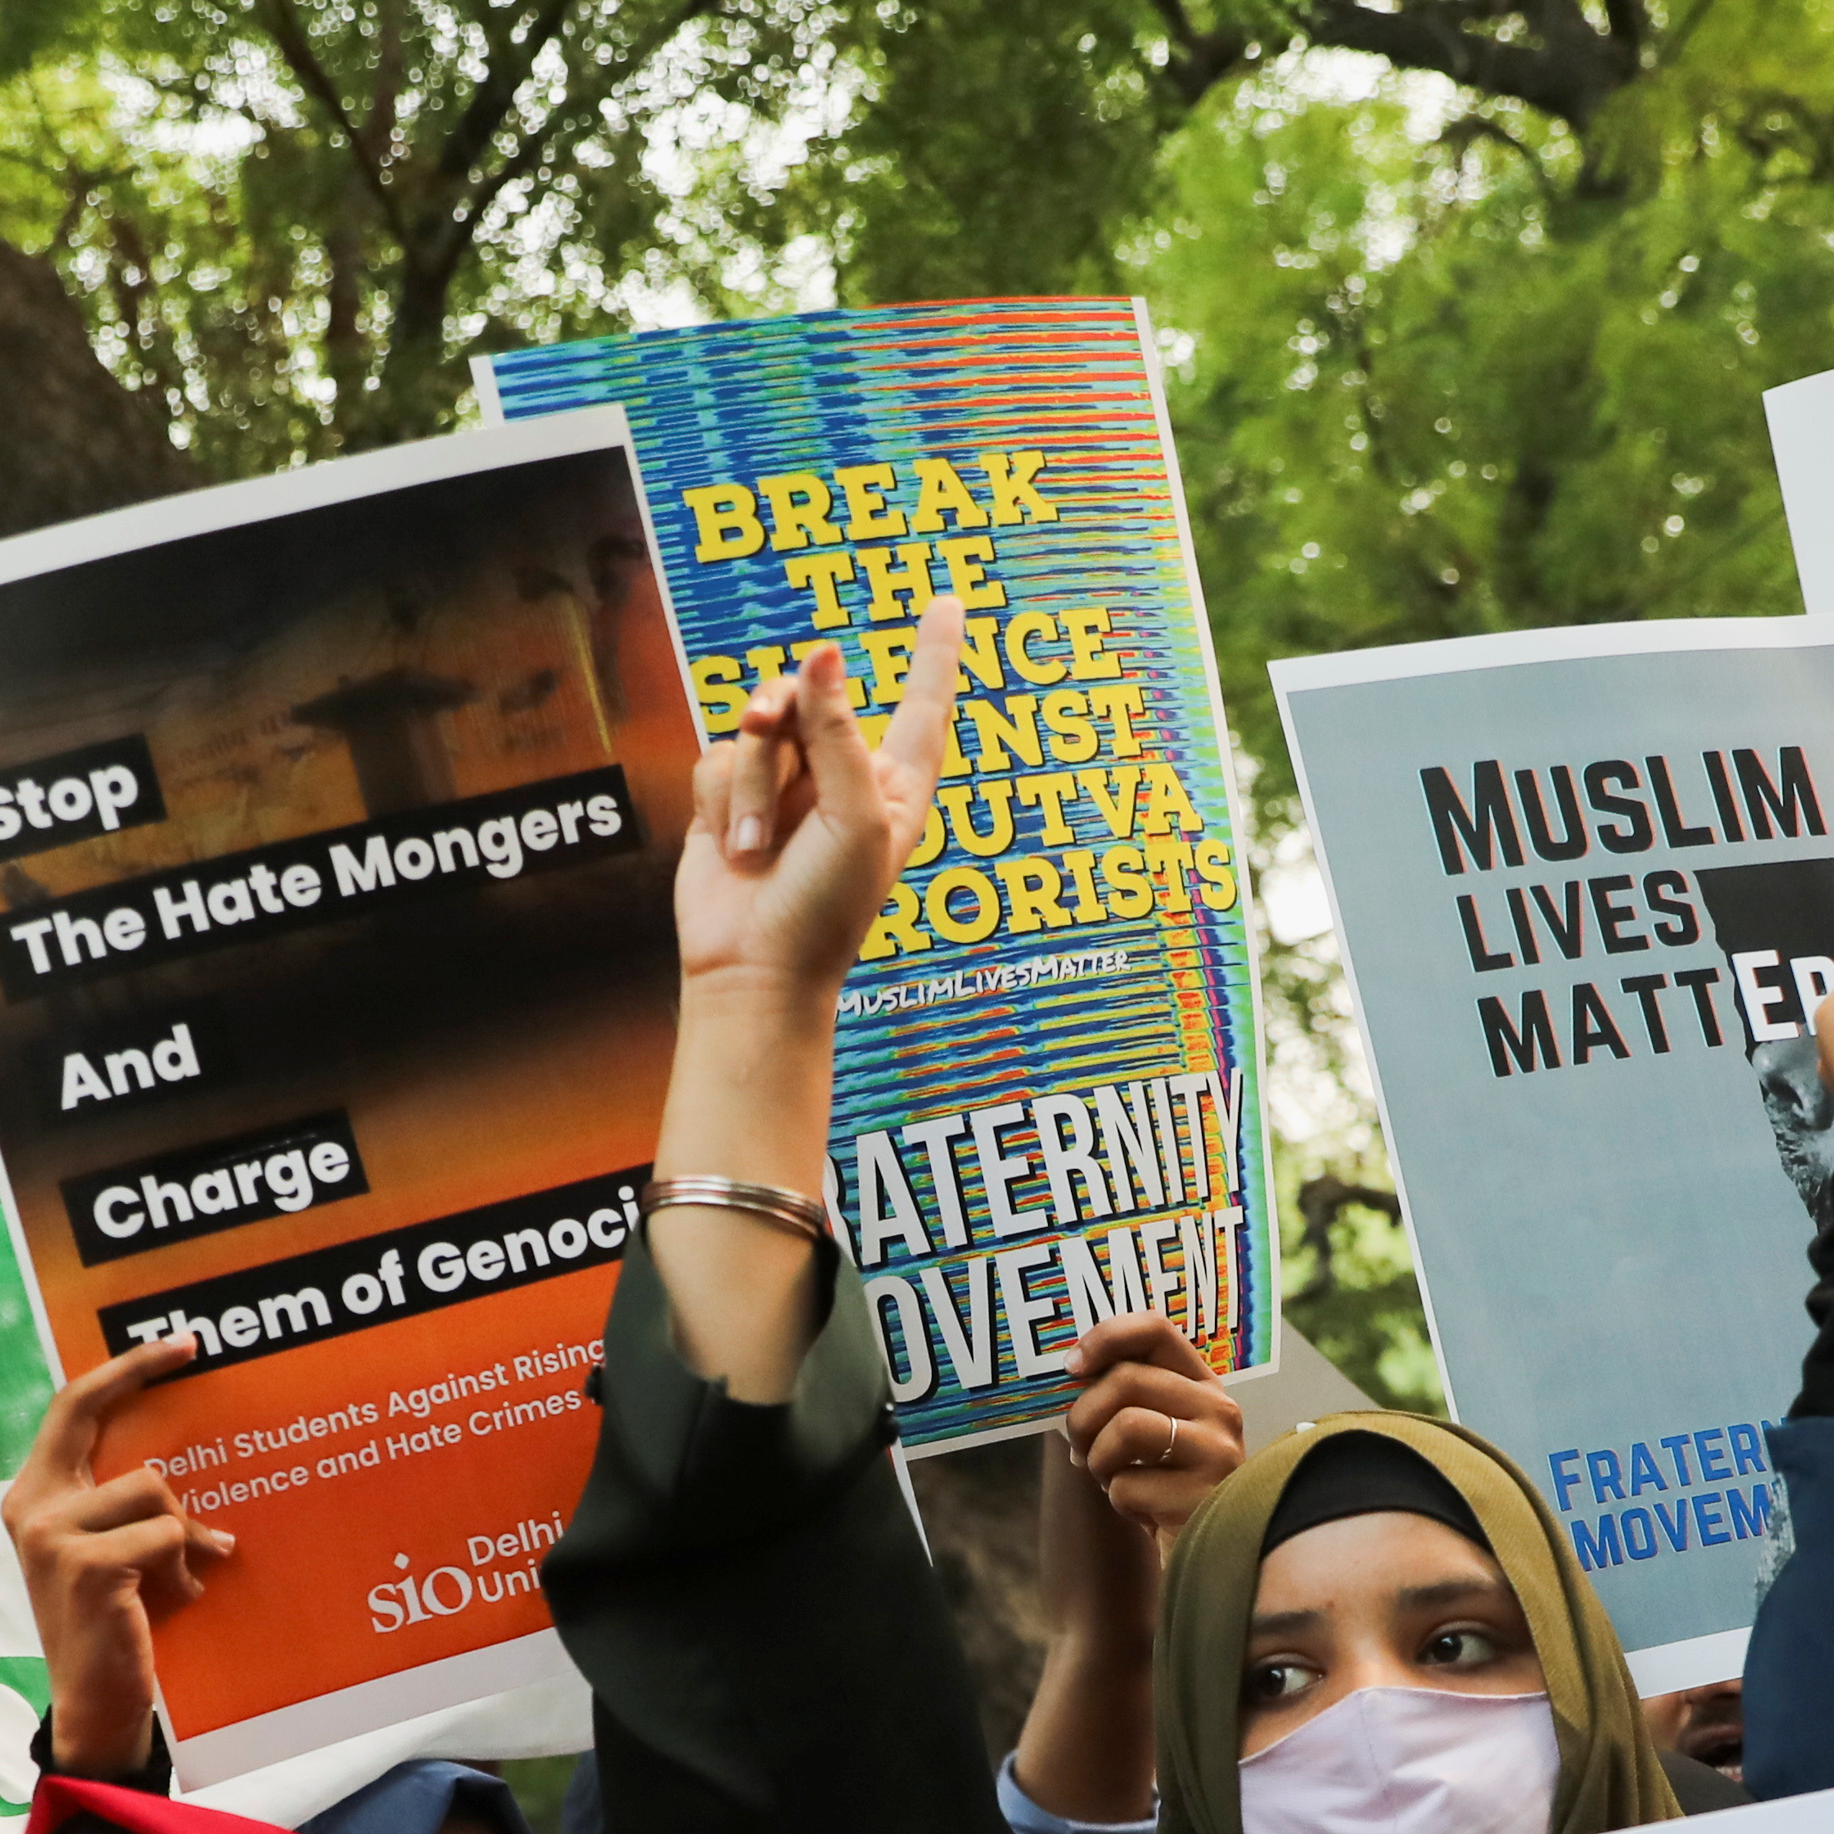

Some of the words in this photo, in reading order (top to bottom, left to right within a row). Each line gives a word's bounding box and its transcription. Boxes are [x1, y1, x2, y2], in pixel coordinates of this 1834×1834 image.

[683, 450, 1060, 565] BREAK
[784, 537, 1007, 630] THE
[1420, 745, 1830, 877] MUSLIM
[11, 903, 147, 975] The
[157, 857, 322, 943] Hate
[331, 790, 623, 898] Mongers
[1455, 869, 1702, 973] LIVES
[58, 1023, 201, 1111] And
[91, 1130, 351, 1240] Charge
[341, 1249, 407, 1316] of
[233, 1400, 379, 1459] Students
[387, 1362, 510, 1419] Against
[316, 1441, 380, 1480] and
[386, 1421, 462, 1460] Hate
[468, 1388, 582, 1437] Crimes
[1547, 1417, 1787, 1512] FRATER
[467, 1511, 566, 1567] Delhi
[1570, 1481, 1778, 1572] MOVEM
